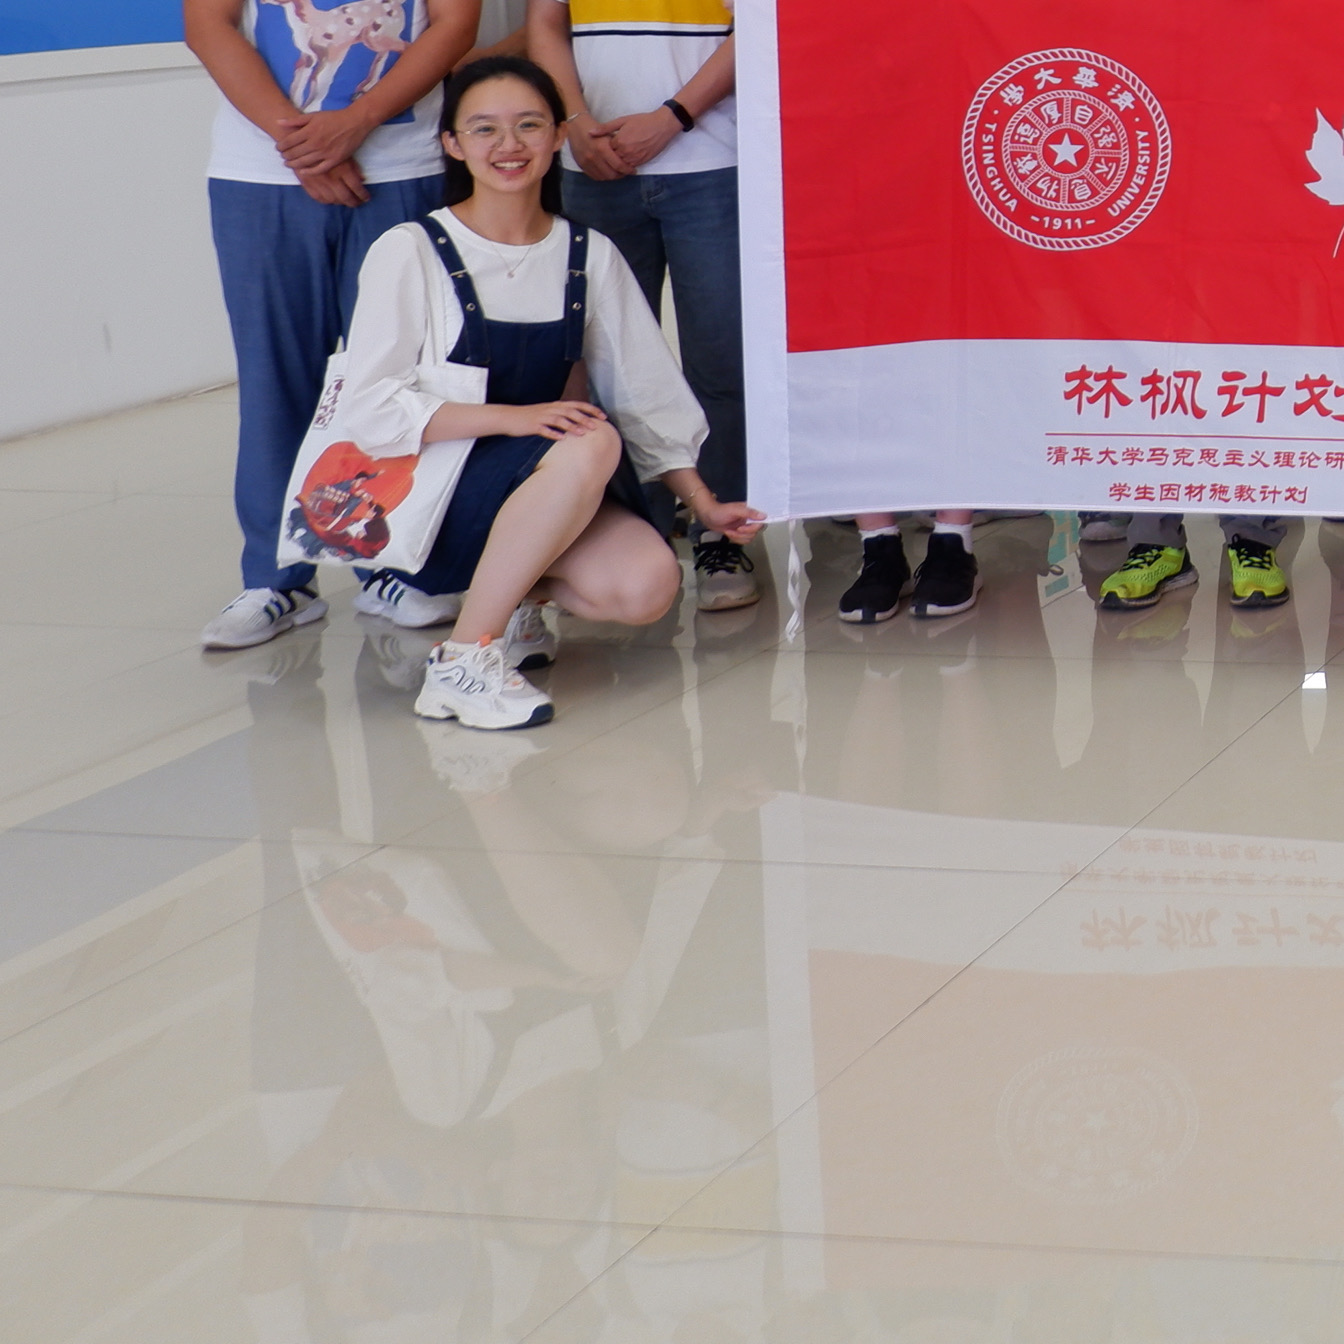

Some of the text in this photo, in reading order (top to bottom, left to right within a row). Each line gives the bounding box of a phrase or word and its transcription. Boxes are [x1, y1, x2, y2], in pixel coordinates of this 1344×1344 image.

[982, 122, 1018, 212] TSINGHUA
[1107, 130, 1150, 217] UNIVERSITY
[1108, 482, 1309, 505] 学生因材施教计划
